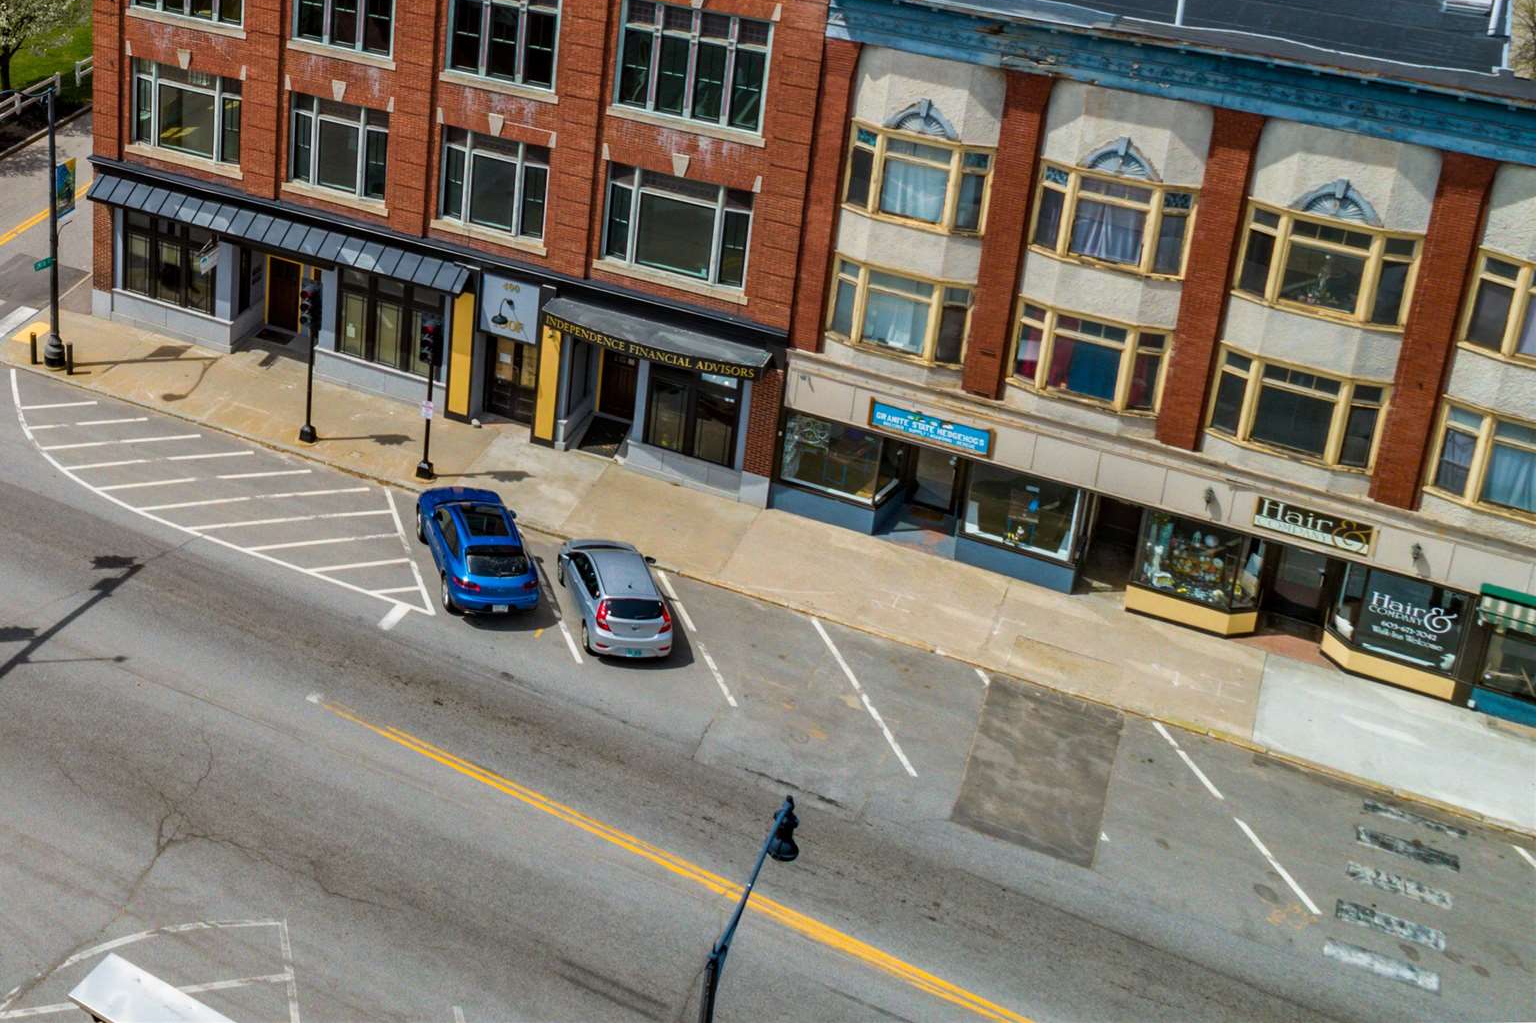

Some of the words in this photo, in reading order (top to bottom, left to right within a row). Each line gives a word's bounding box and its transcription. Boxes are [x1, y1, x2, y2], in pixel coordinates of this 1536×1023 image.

[545, 314, 626, 352] INDEPENDENCE
[629, 344, 693, 369] FINANCIAL
[695, 360, 755, 379] ADVISORS
[875, 411, 910, 427] GRANITE
[911, 420, 935, 434] STATE
[1256, 516, 1330, 543] COMPANY
[1262, 498, 1334, 533] Hair
[1331, 520, 1375, 551] &
[1368, 605, 1424, 626] COMPANY
[1371, 591, 1427, 618] Hair
[1424, 607, 1459, 634] &
